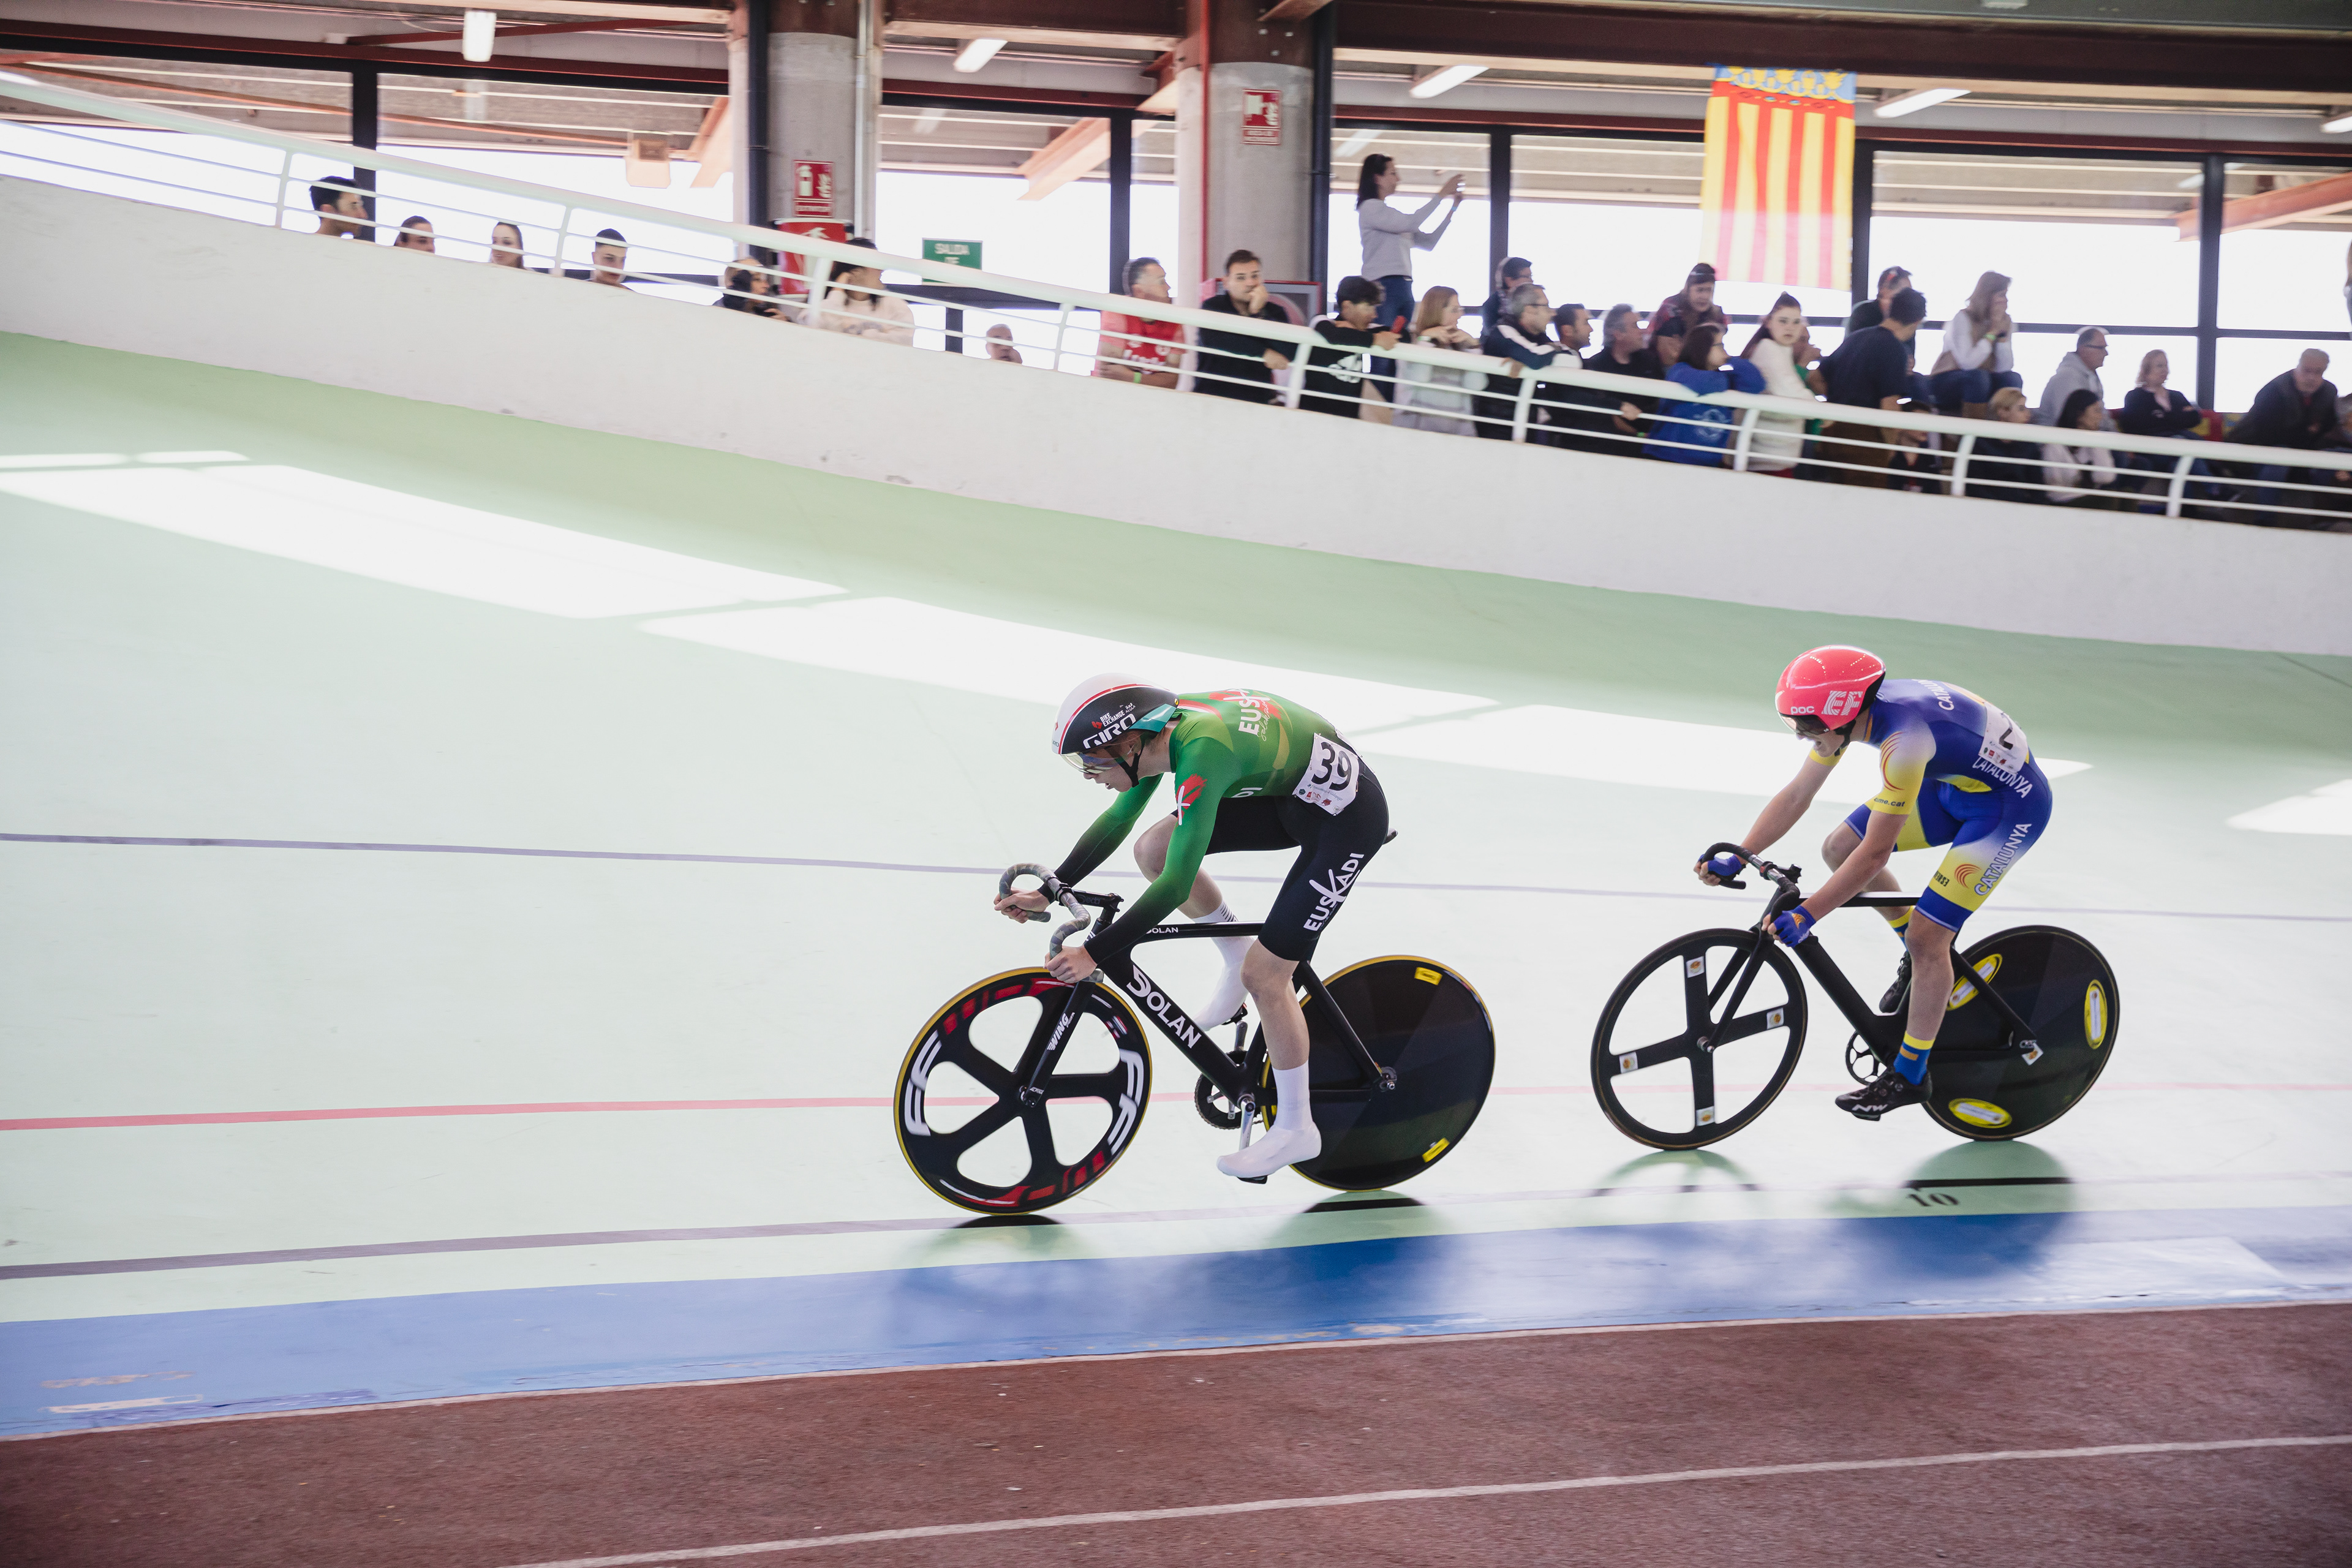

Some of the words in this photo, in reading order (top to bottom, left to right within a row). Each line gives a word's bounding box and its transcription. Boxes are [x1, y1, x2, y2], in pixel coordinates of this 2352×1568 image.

[934, 243, 970, 255] SALIDA
[1099, 712, 1112, 722] BIKE
[1102, 710, 1126, 727] EXCHANGE
[1821, 690, 1863, 716] EF
[1083, 713, 1136, 749] GIRO
[1311, 742, 1352, 791] 39
[1974, 823, 2032, 896] CATALUNYA
[1303, 853, 1365, 932] EUSKADI
[1126, 965, 1202, 1049] DOLAN
[1047, 1012, 1069, 1050] WING
[1906, 1194, 1958, 1207] 10
